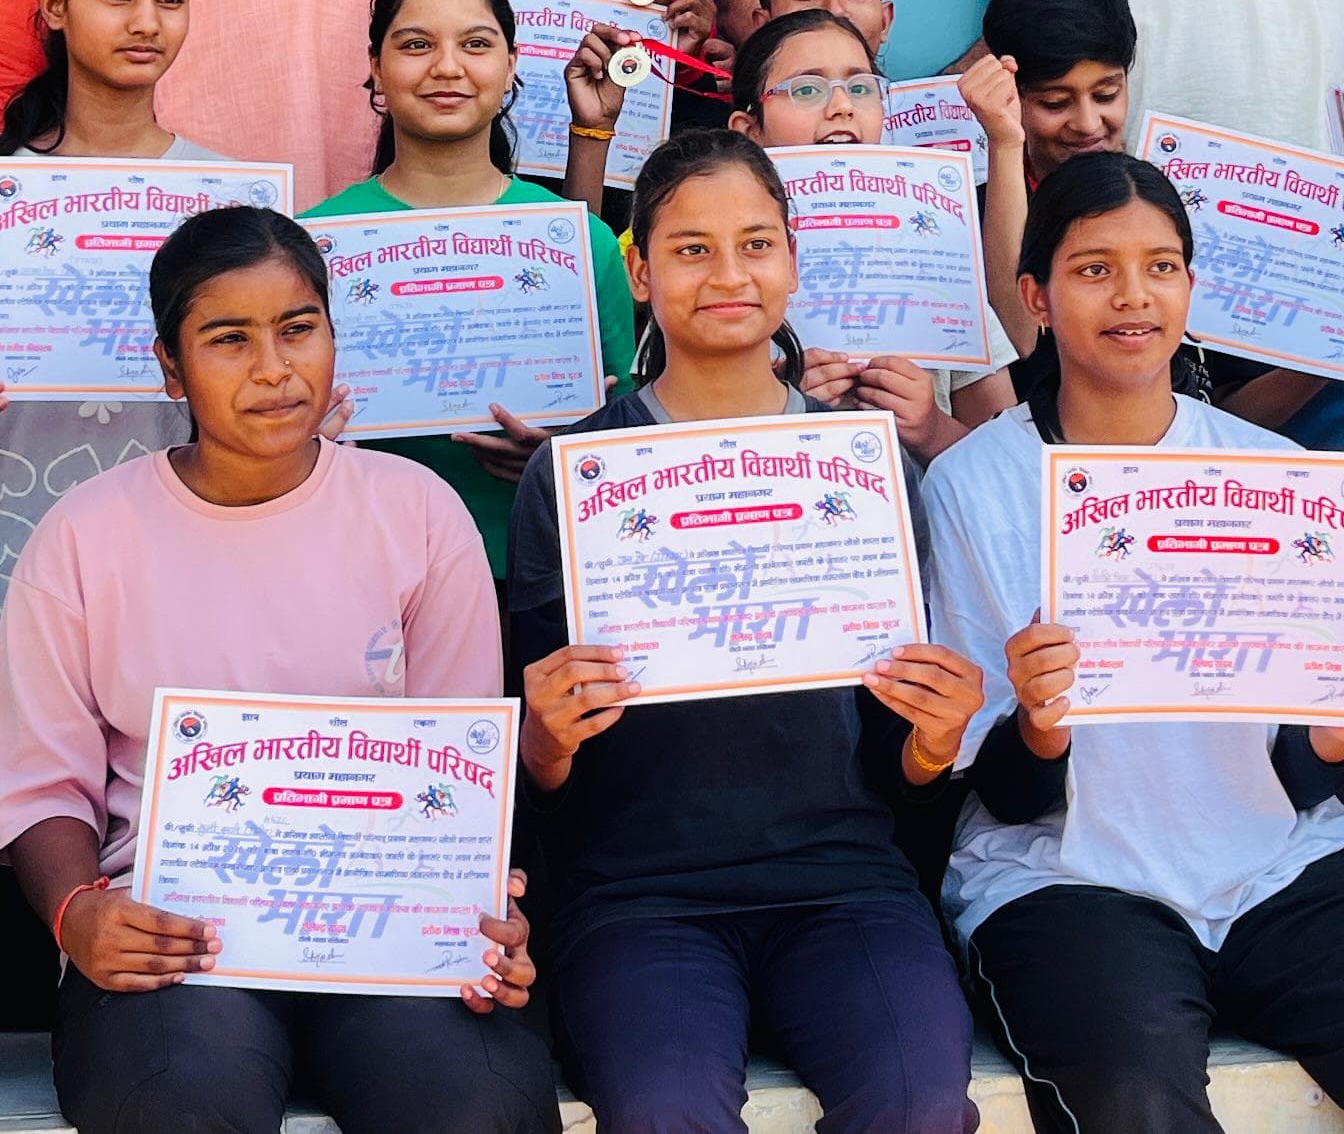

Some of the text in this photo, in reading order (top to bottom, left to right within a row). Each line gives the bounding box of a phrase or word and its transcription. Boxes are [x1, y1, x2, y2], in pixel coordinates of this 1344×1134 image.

[784, 166, 844, 191] ारतीय
[1158, 156, 1211, 181] खिल
[328, 250, 372, 281] खिल
[580, 474, 647, 520] अखिल
[653, 454, 734, 490] भारतीय
[739, 450, 811, 479] विद्यार्थी
[1063, 494, 1130, 533] अखिल
[1135, 479, 1217, 511] भारतीय
[170, 741, 247, 782] अखिल
[253, 728, 340, 759] भारतीय
[347, 728, 420, 768] विद्यार्थी
